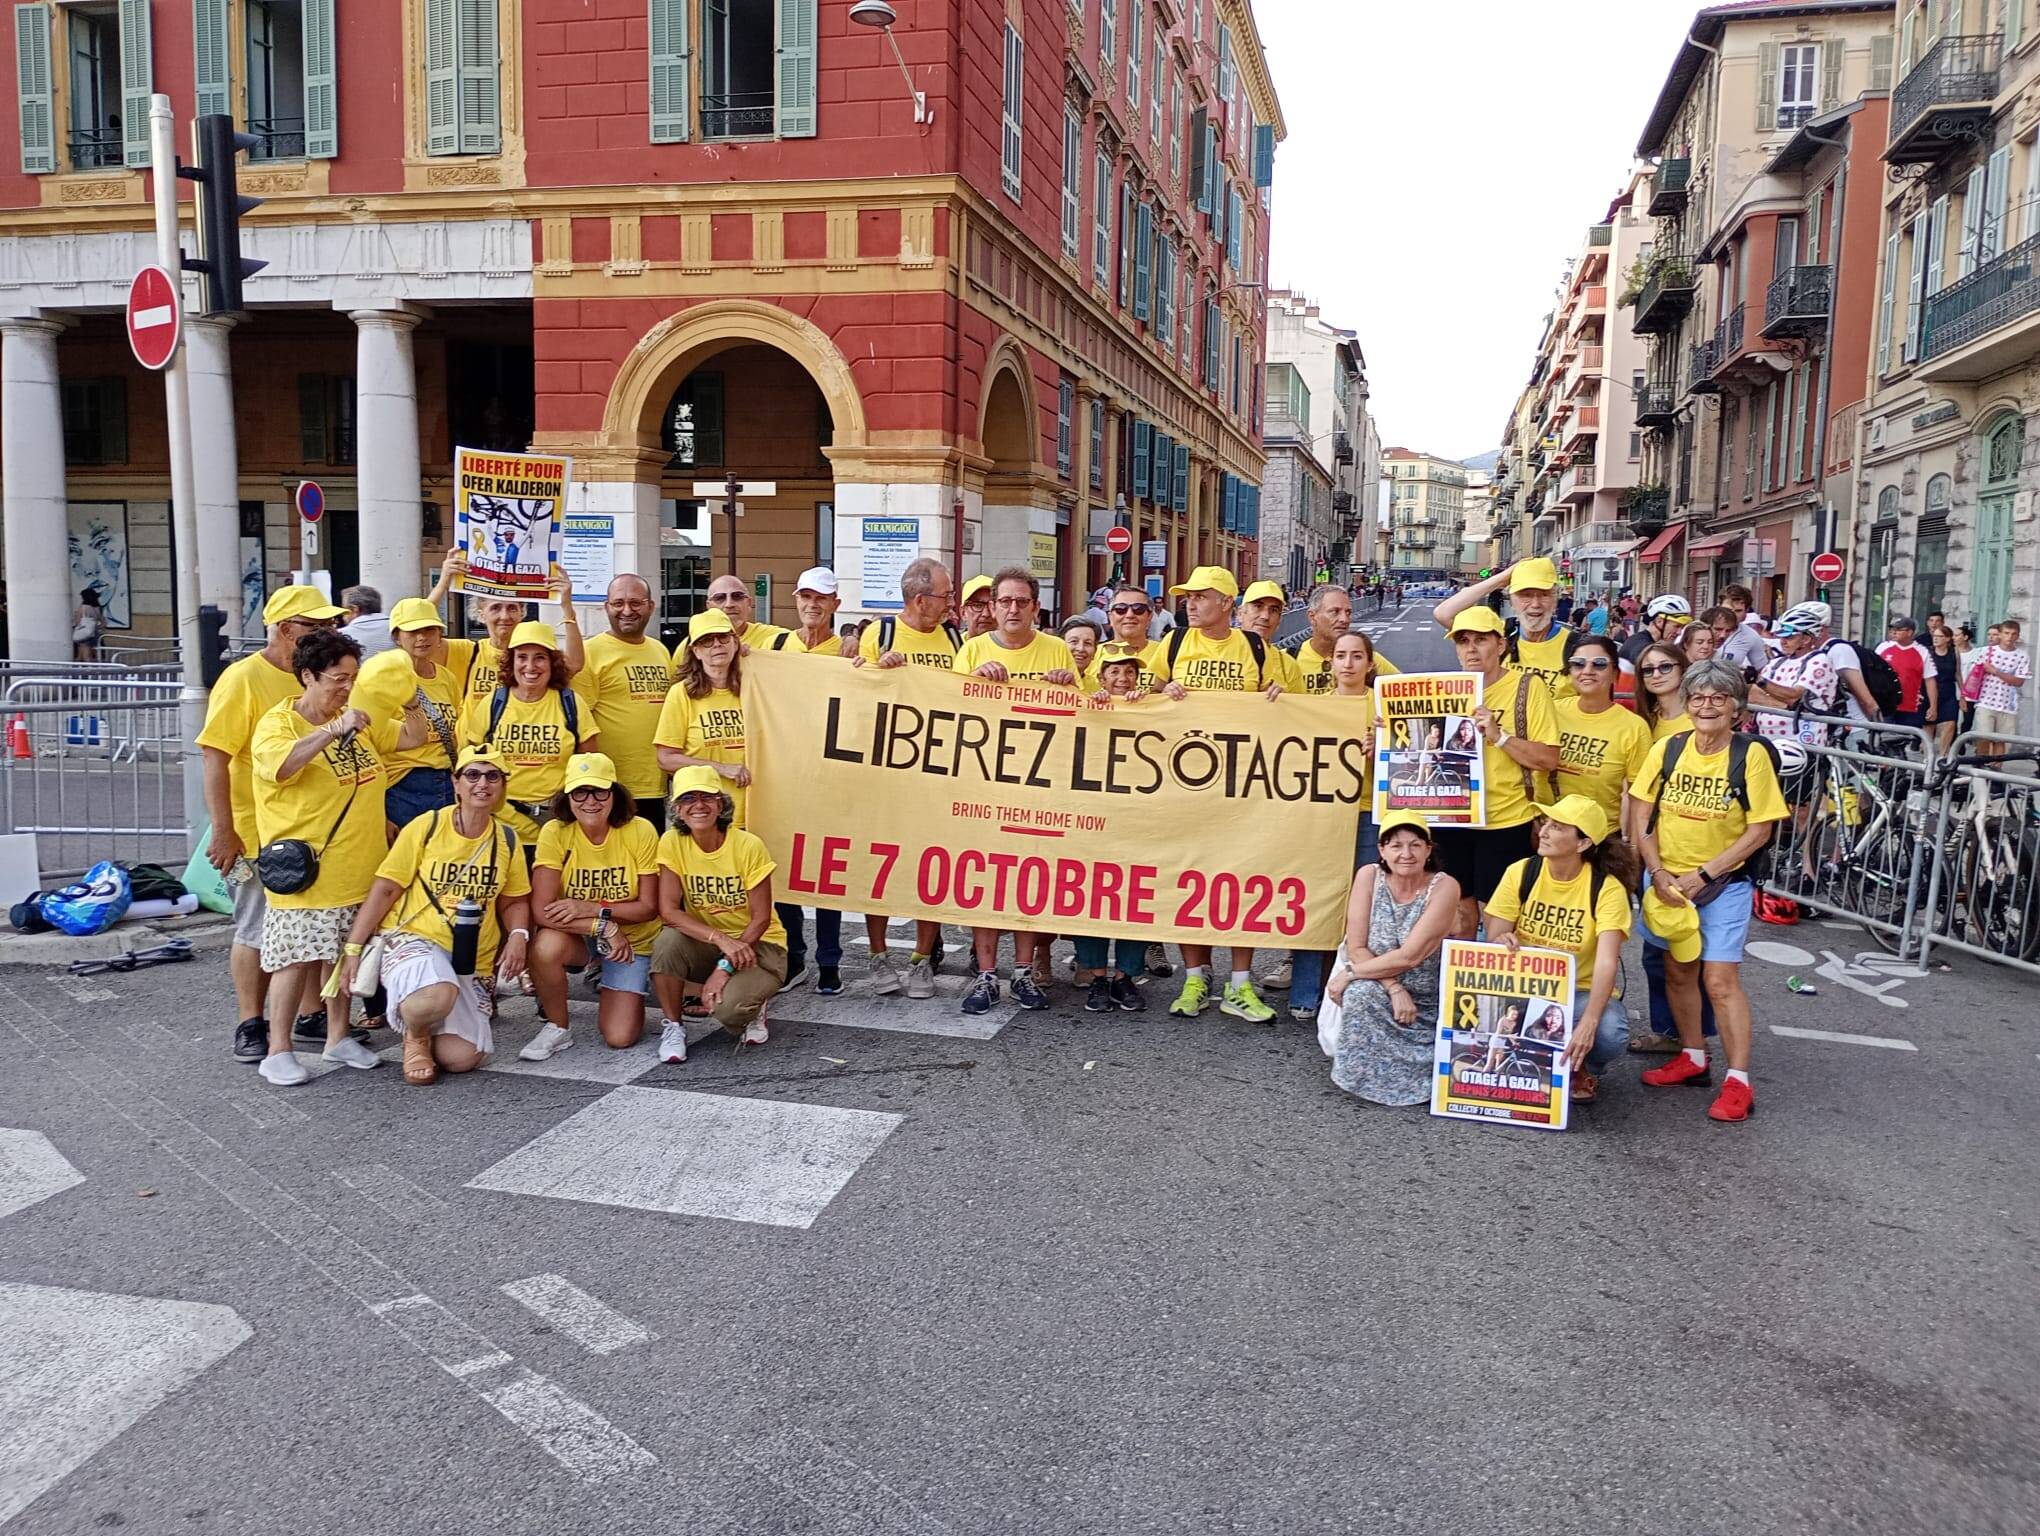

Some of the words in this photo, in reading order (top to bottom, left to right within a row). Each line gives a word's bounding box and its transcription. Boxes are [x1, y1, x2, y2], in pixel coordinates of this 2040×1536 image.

[462, 455, 521, 477] LIBERTÉ
[525, 463, 563, 479] POUR
[462, 474, 493, 493] OFER
[496, 479, 561, 497] KALDERON
[476, 557, 506, 573] OTAGE
[515, 565, 540, 574] GAZA
[624, 665, 670, 682] LIBEREZ
[1187, 660, 1244, 679] LIBEREZ
[629, 681, 646, 692] LES
[1184, 676, 1202, 688] LES
[1206, 677, 1245, 691] OTAGES
[1381, 678, 1432, 698] LIBERTÉ
[1436, 679, 1474, 696] POUR
[963, 682, 1002, 700] BRING
[1007, 687, 1042, 704] THEM
[1046, 690, 1082, 708] HOME
[1387, 699, 1434, 716] NAAMA
[1437, 698, 1468, 714] LEVY
[496, 723, 560, 742] LIBEREZ
[702, 726, 723, 740] LES
[518, 741, 560, 754] OTAGES
[823, 696, 1057, 789] LIBEREZ
[1070, 726, 1166, 794] LES
[1560, 750, 1604, 768] OTAGES
[1397, 785, 1428, 797] OTAGE
[1428, 785, 1436, 797] A
[1436, 785, 1462, 797] GAZA
[952, 801, 992, 819] BRING
[996, 806, 1031, 824] THEM
[1035, 810, 1072, 828] HOME
[1076, 814, 1106, 832] NOW
[429, 861, 499, 886] LIBEREZ
[569, 866, 628, 888] LIBEREZ
[566, 886, 586, 901] LES
[589, 885, 630, 901] OTAGES
[788, 832, 851, 897] LE
[870, 842, 900, 900] 7
[917, 846, 1157, 925] OCTOBRE
[1174, 869, 1307, 937] 2023
[706, 892, 747, 907] OTAGES
[1538, 923, 1584, 944] OTAGES
[1450, 948, 1516, 973] LIBERTÉ
[1520, 955, 1566, 977] POUR
[1454, 969, 1515, 994] NAAMA
[1519, 974, 1560, 998] LEVY
[1461, 1070, 1498, 1087] OTAGE
[1498, 1074, 1508, 1088] A
[1509, 1075, 1539, 1091] GAZA
